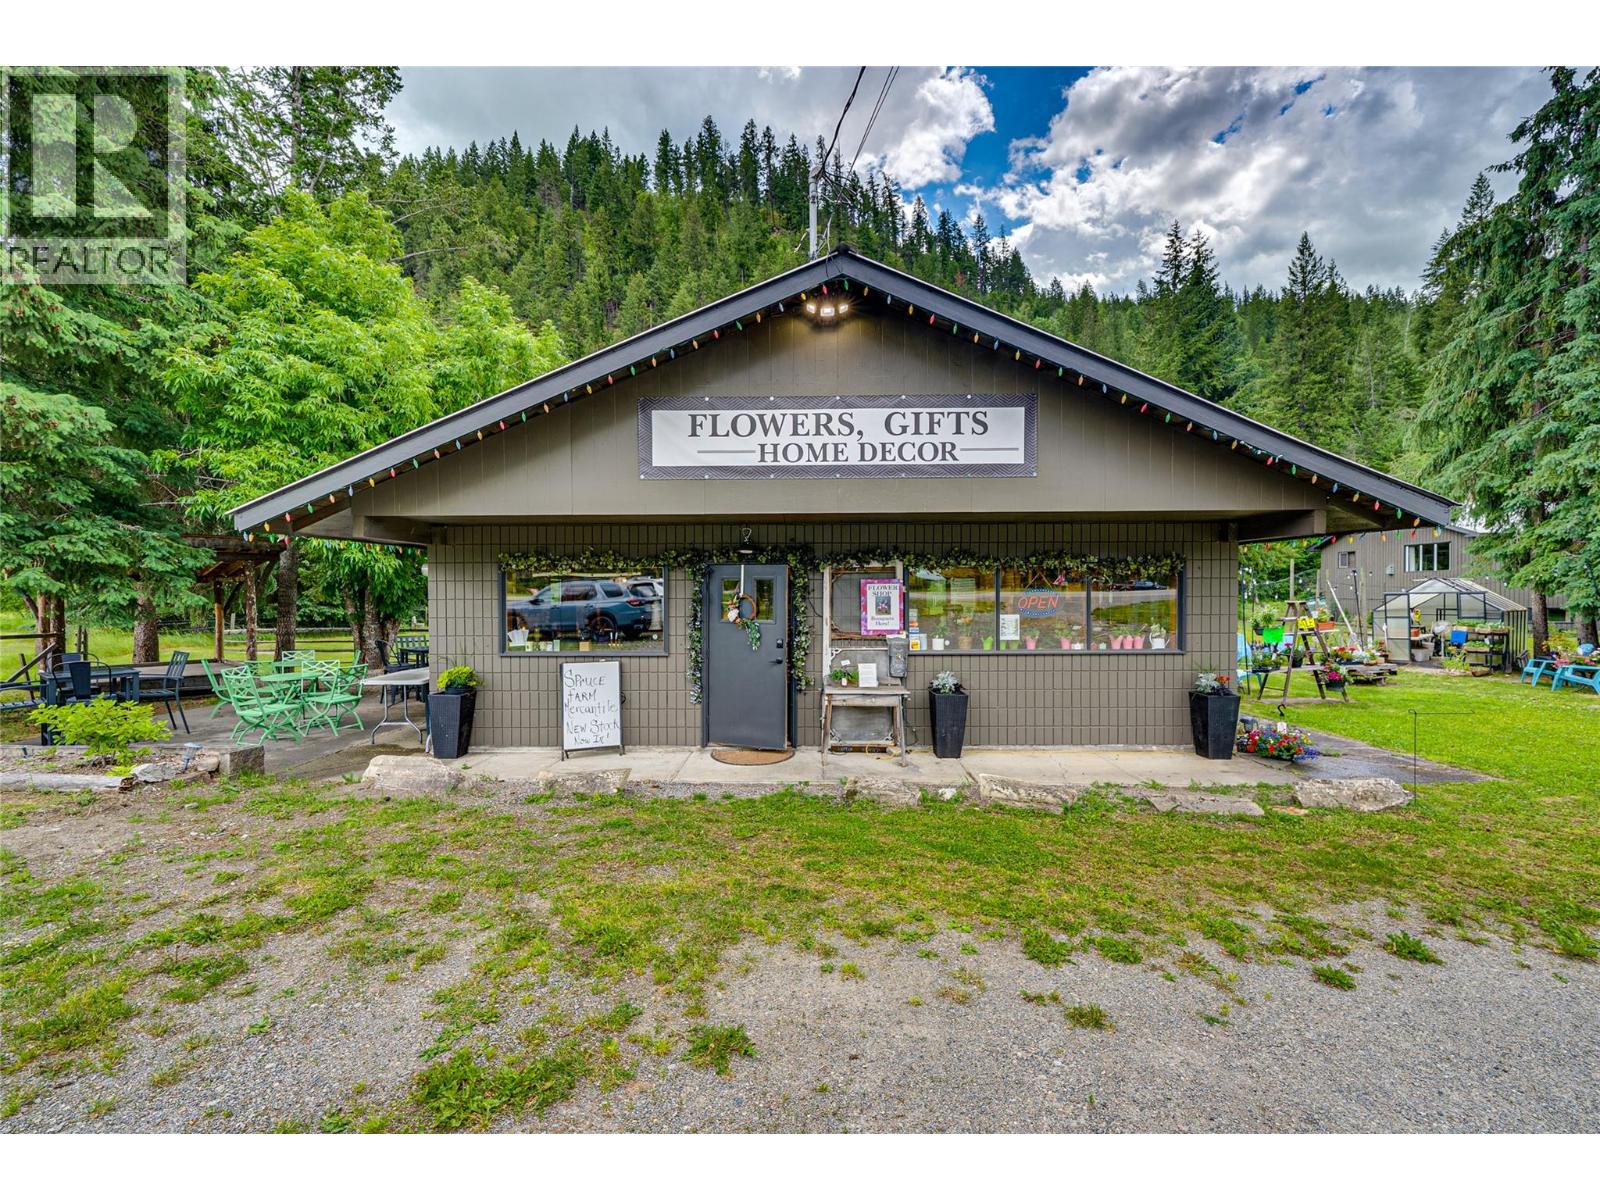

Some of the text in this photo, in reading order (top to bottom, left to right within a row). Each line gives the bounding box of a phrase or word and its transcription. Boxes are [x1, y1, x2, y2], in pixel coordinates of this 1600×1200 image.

[687, 411, 989, 442] FLOWERS, GIFTS
[757, 441, 960, 463] HOME DECOR
[1017, 595, 1060, 609] OPEN
